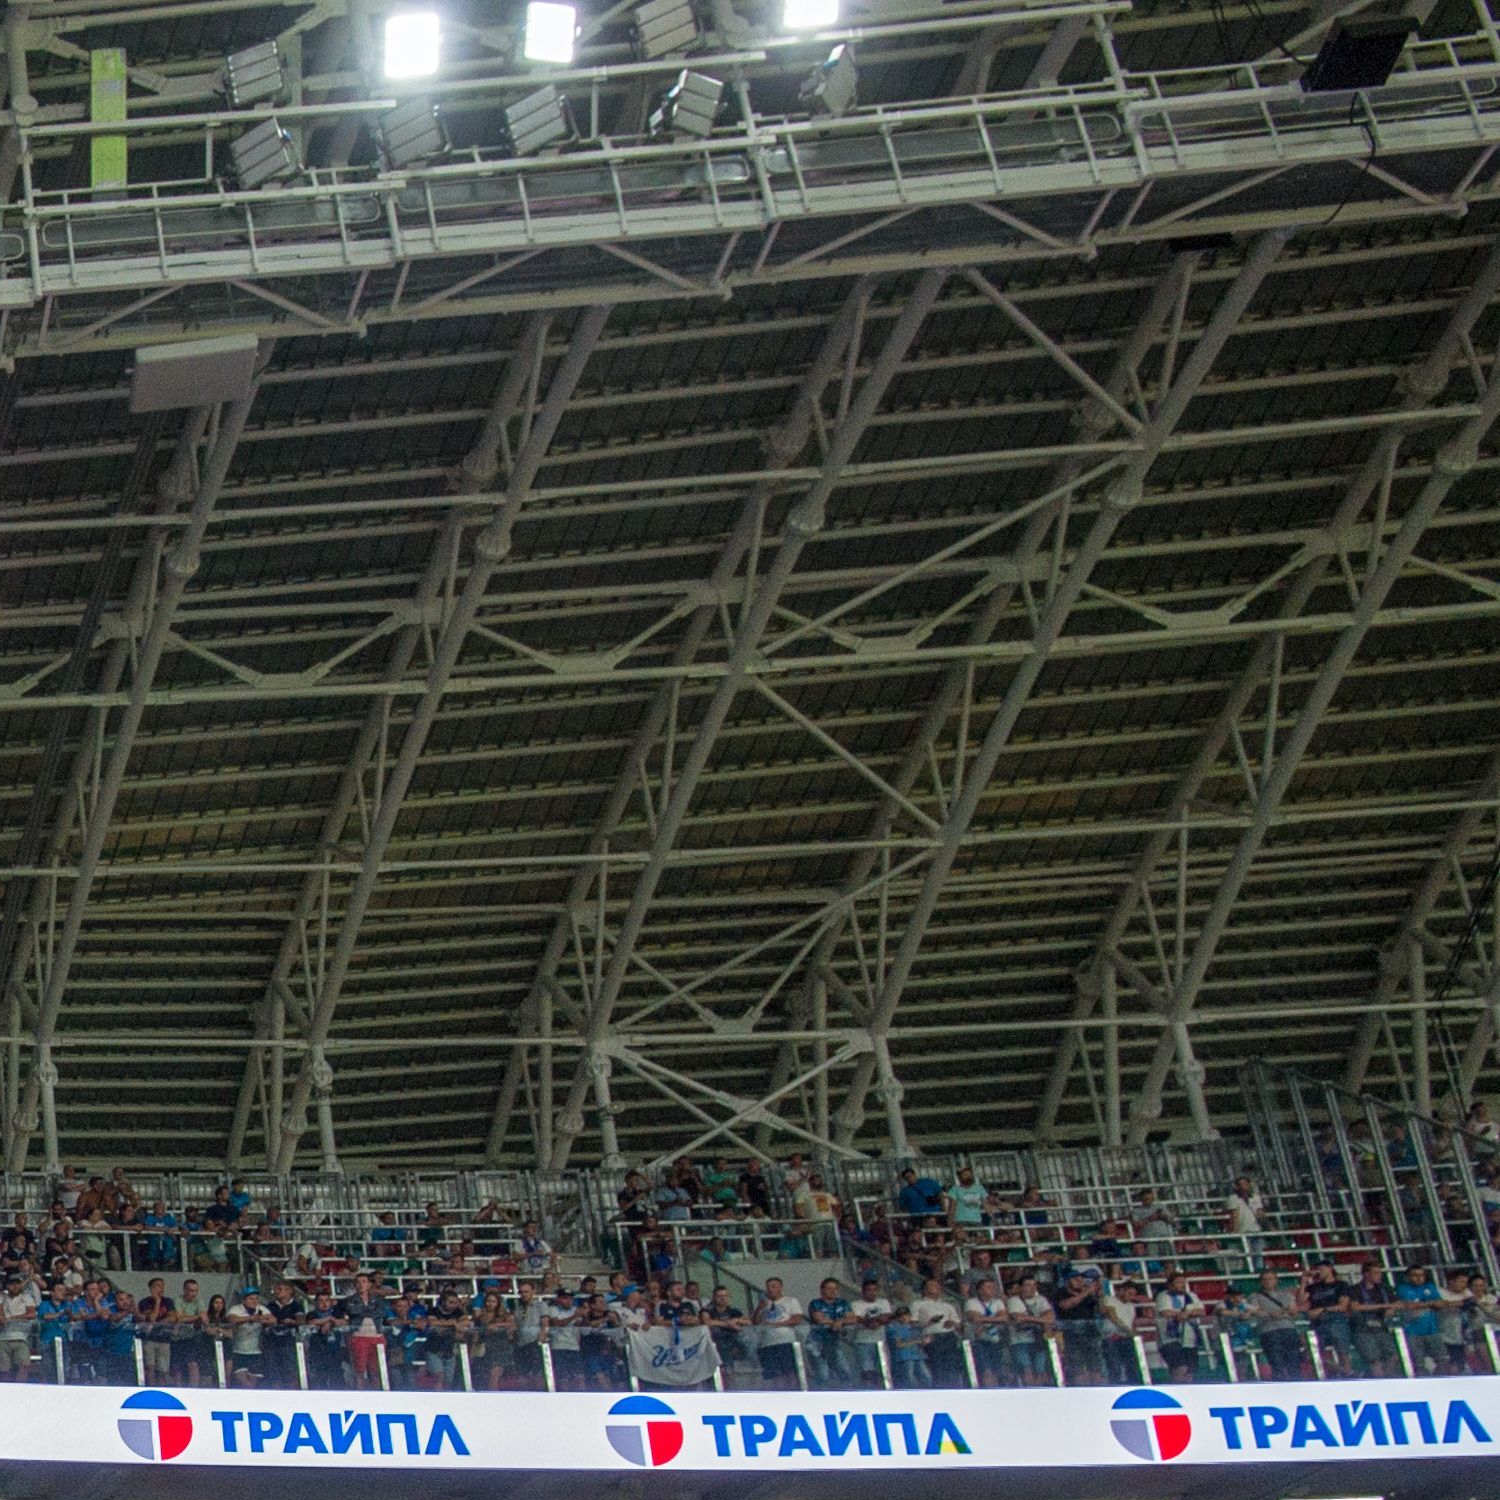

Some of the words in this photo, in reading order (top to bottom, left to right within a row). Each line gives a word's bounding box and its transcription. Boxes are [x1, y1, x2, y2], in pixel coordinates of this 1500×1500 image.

[211, 1410, 471, 1456] ТРАЙПЛ
[701, 1410, 973, 1457] ТРАЙПЛ
[1209, 1399, 1492, 1450] ТРАЙПЛ
